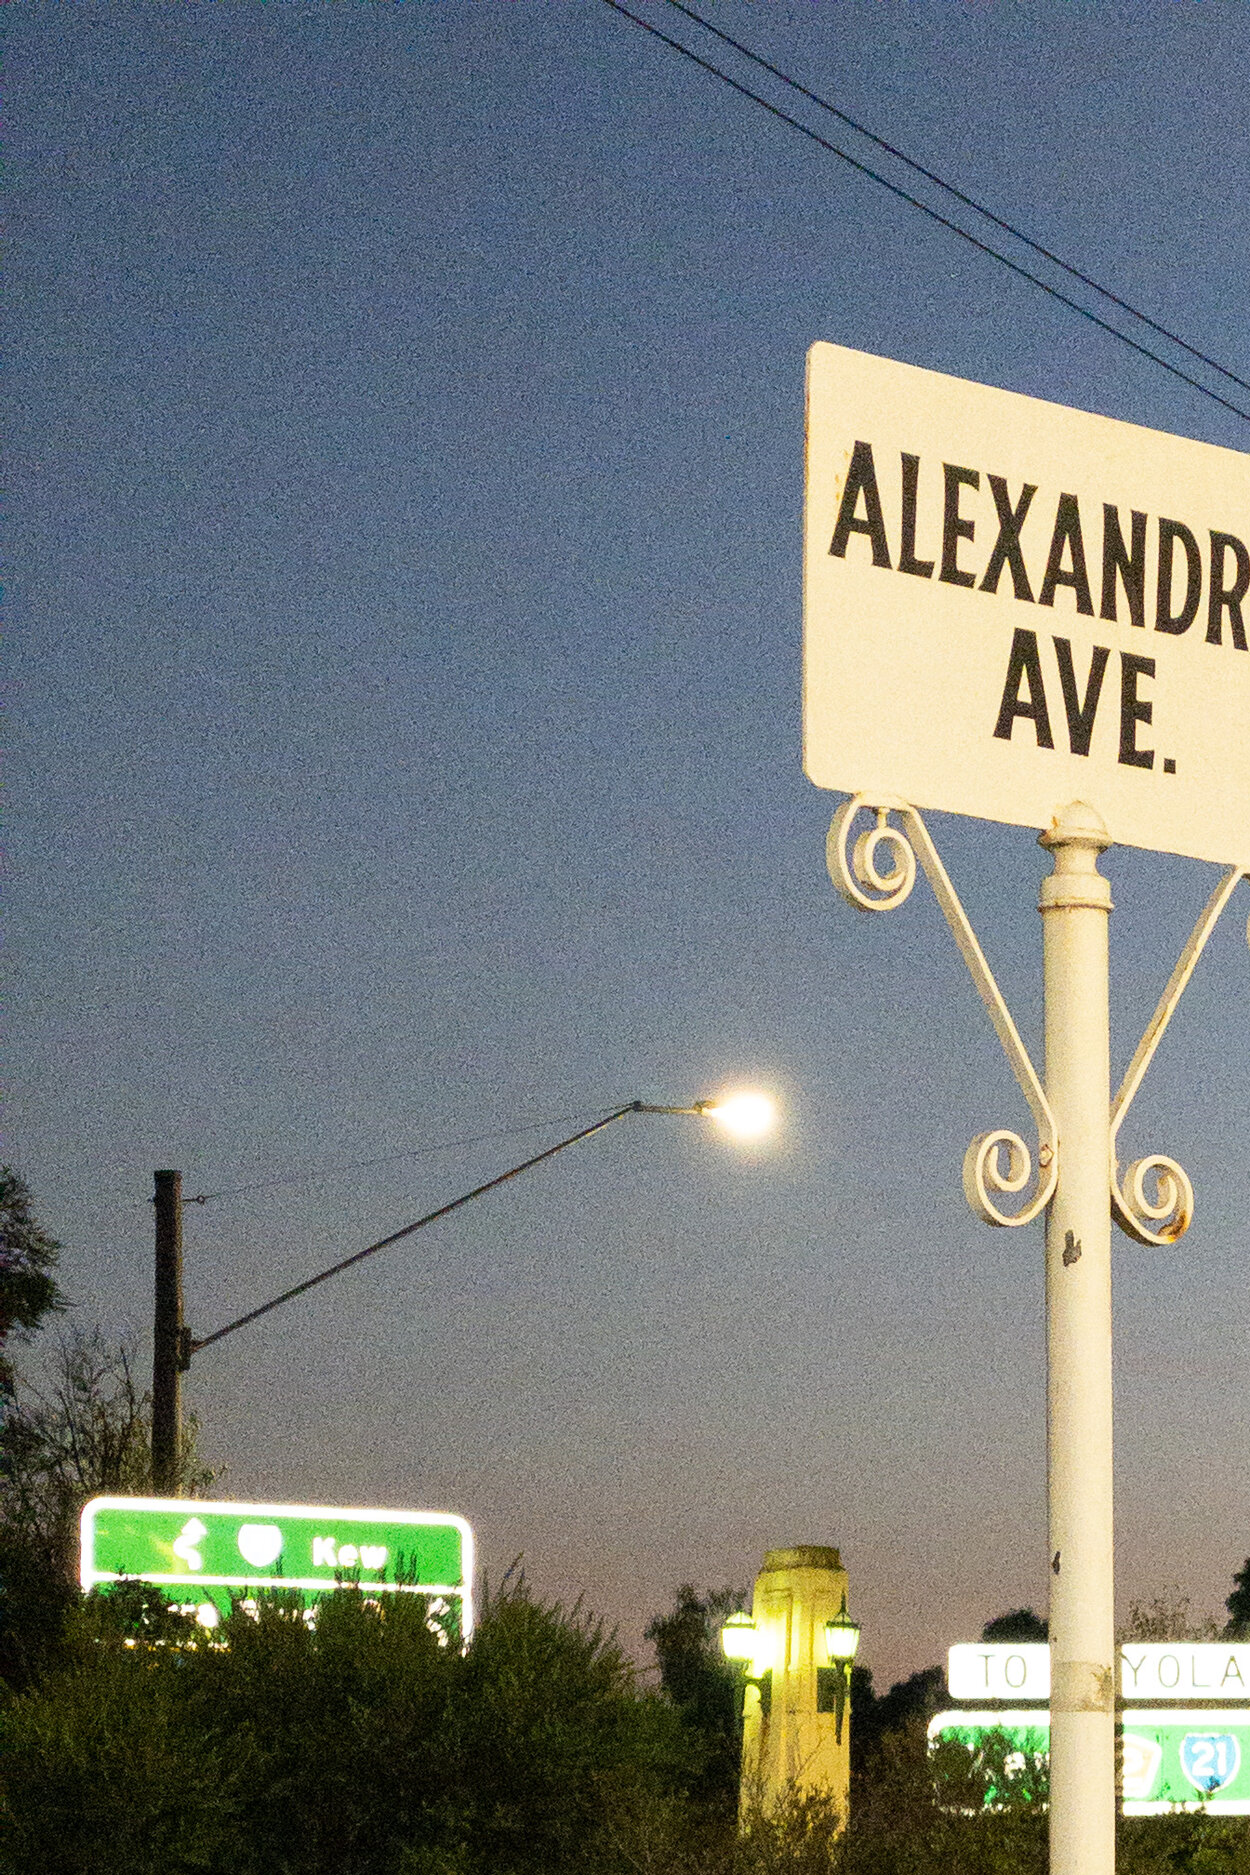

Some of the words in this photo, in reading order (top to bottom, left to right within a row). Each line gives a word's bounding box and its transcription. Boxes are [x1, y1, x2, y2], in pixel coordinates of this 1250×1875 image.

[993, 627, 1177, 774] AVE.
[312, 1536, 388, 1569] Kew
[977, 1654, 1028, 1688] TO
[1121, 1654, 1246, 1688] YOLA
[1191, 1741, 1227, 1777] 21
